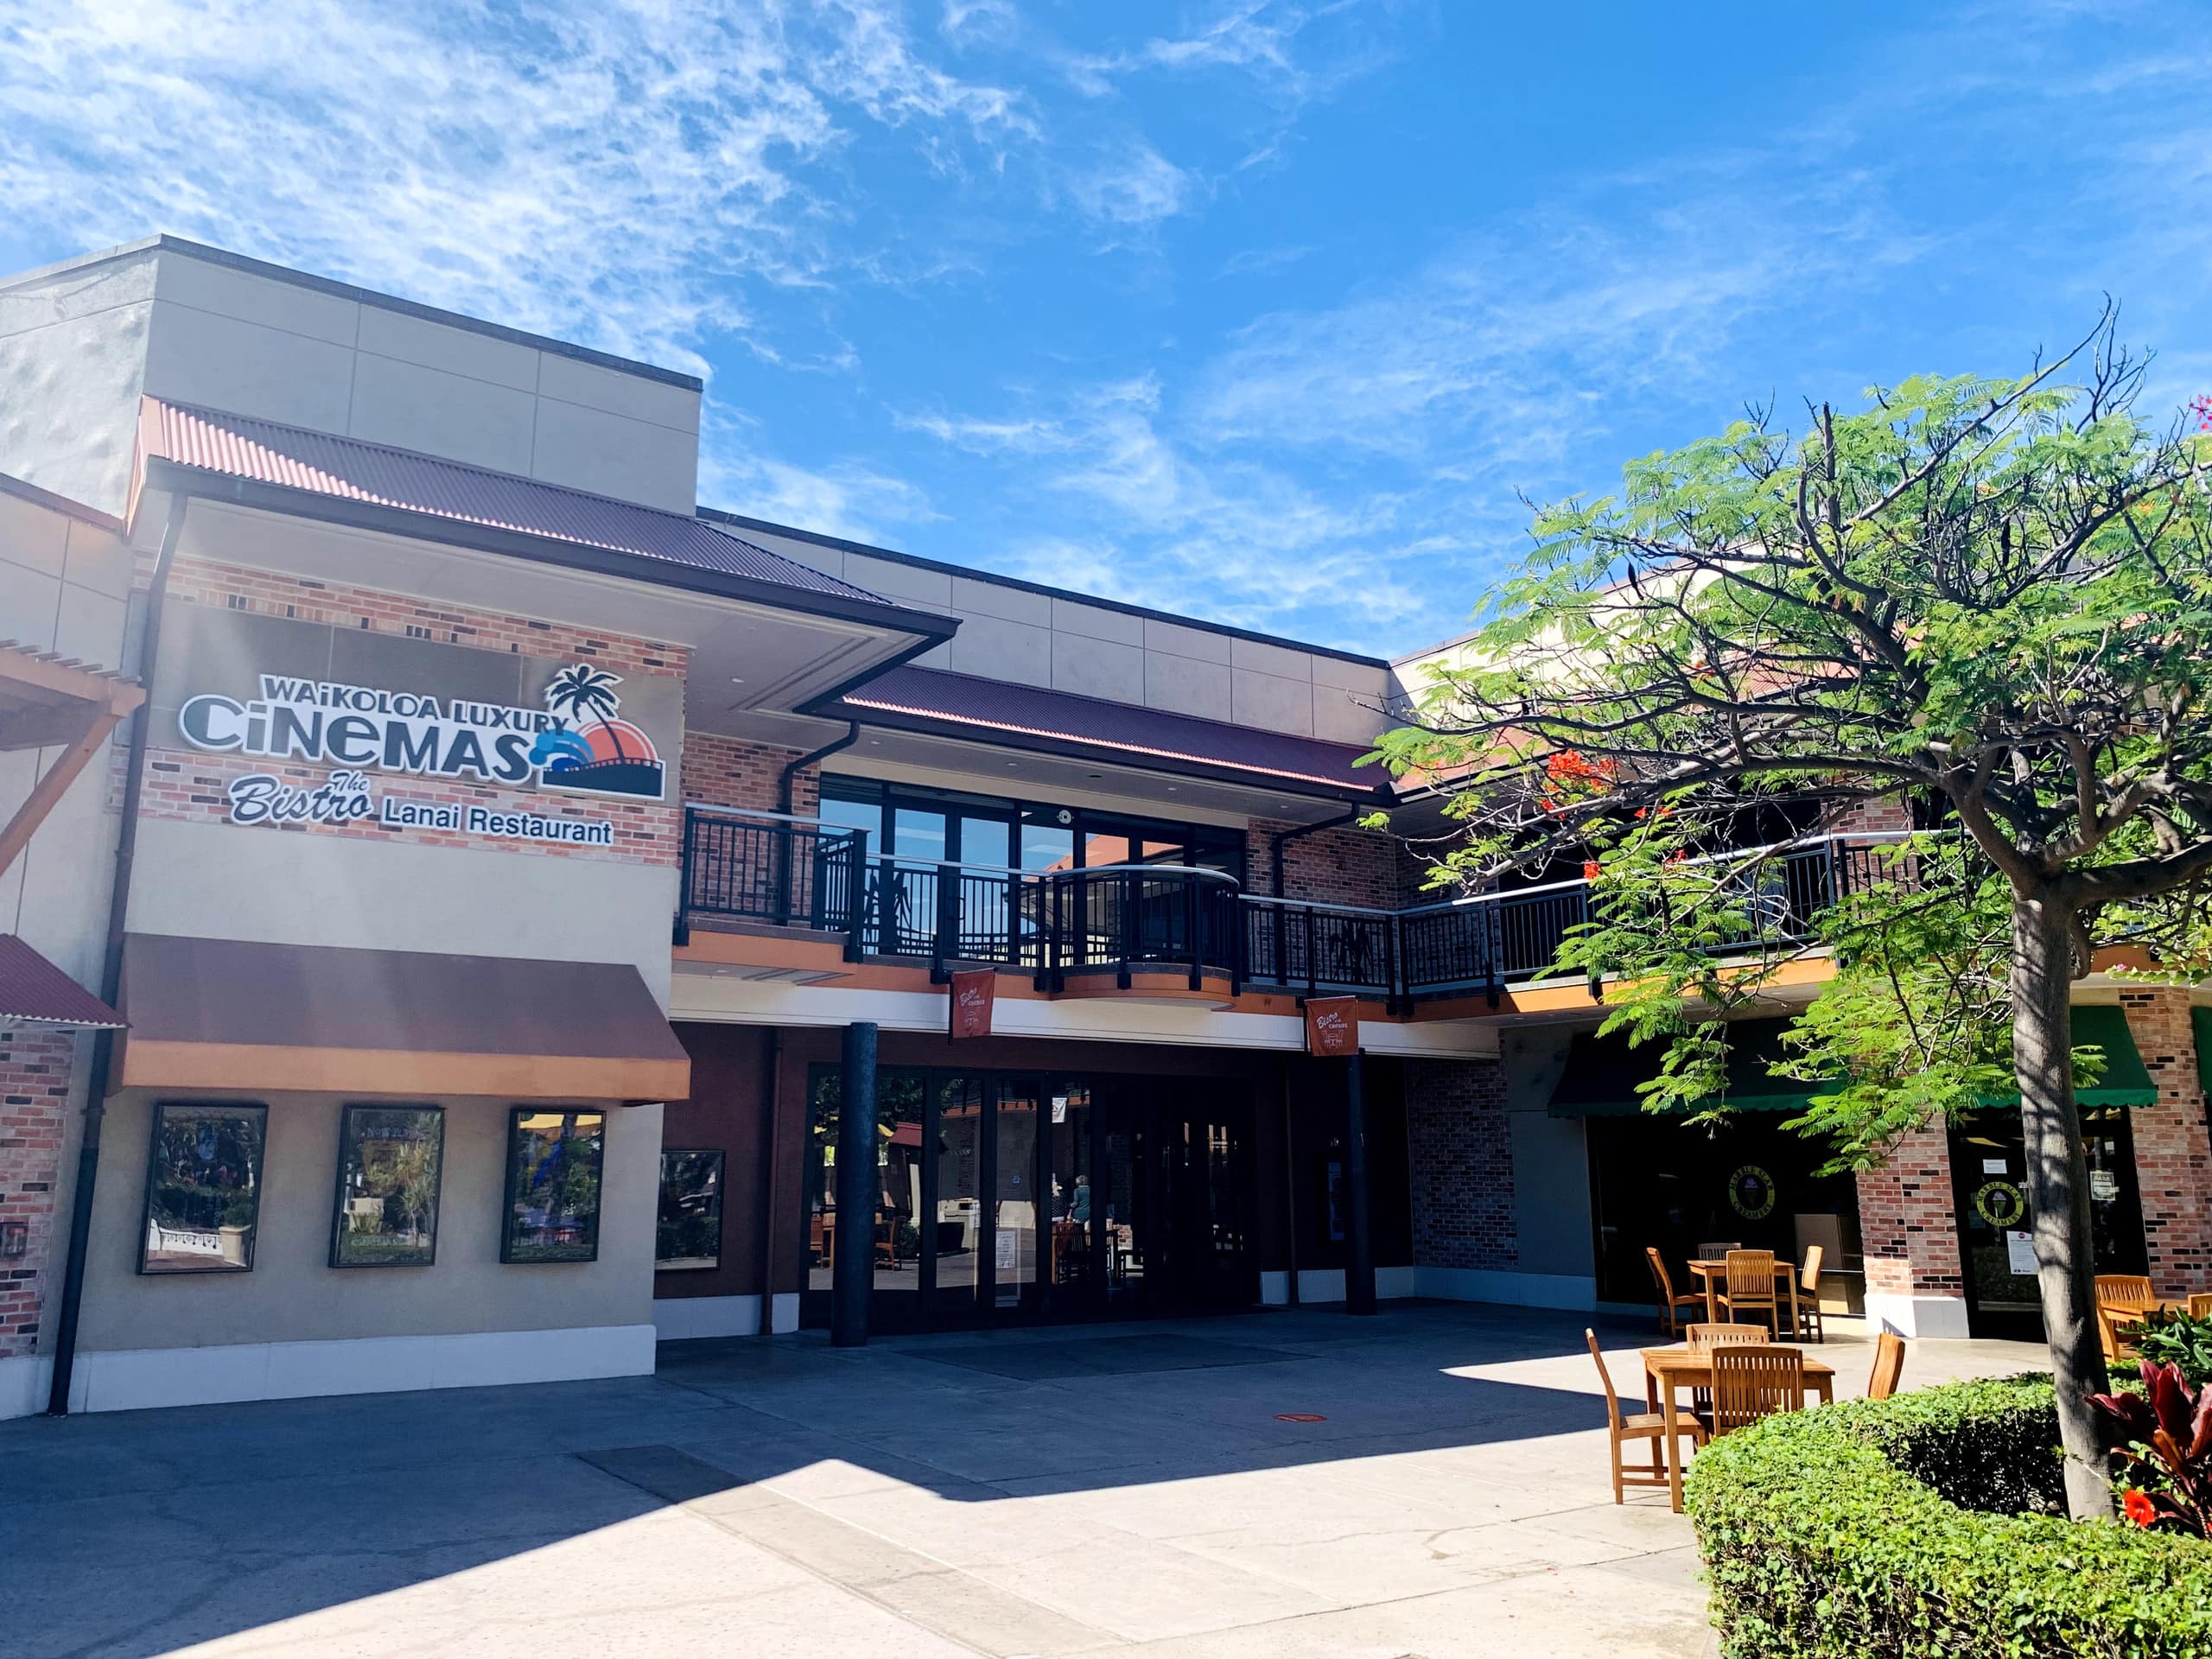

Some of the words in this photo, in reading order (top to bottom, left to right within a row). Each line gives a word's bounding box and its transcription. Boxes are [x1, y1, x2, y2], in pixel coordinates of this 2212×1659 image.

[452, 702, 570, 736] LUXURY
[230, 776, 372, 822] Bistro
[332, 771, 368, 792] The
[383, 798, 460, 830] Lanai
[468, 807, 613, 845] Restaurant
